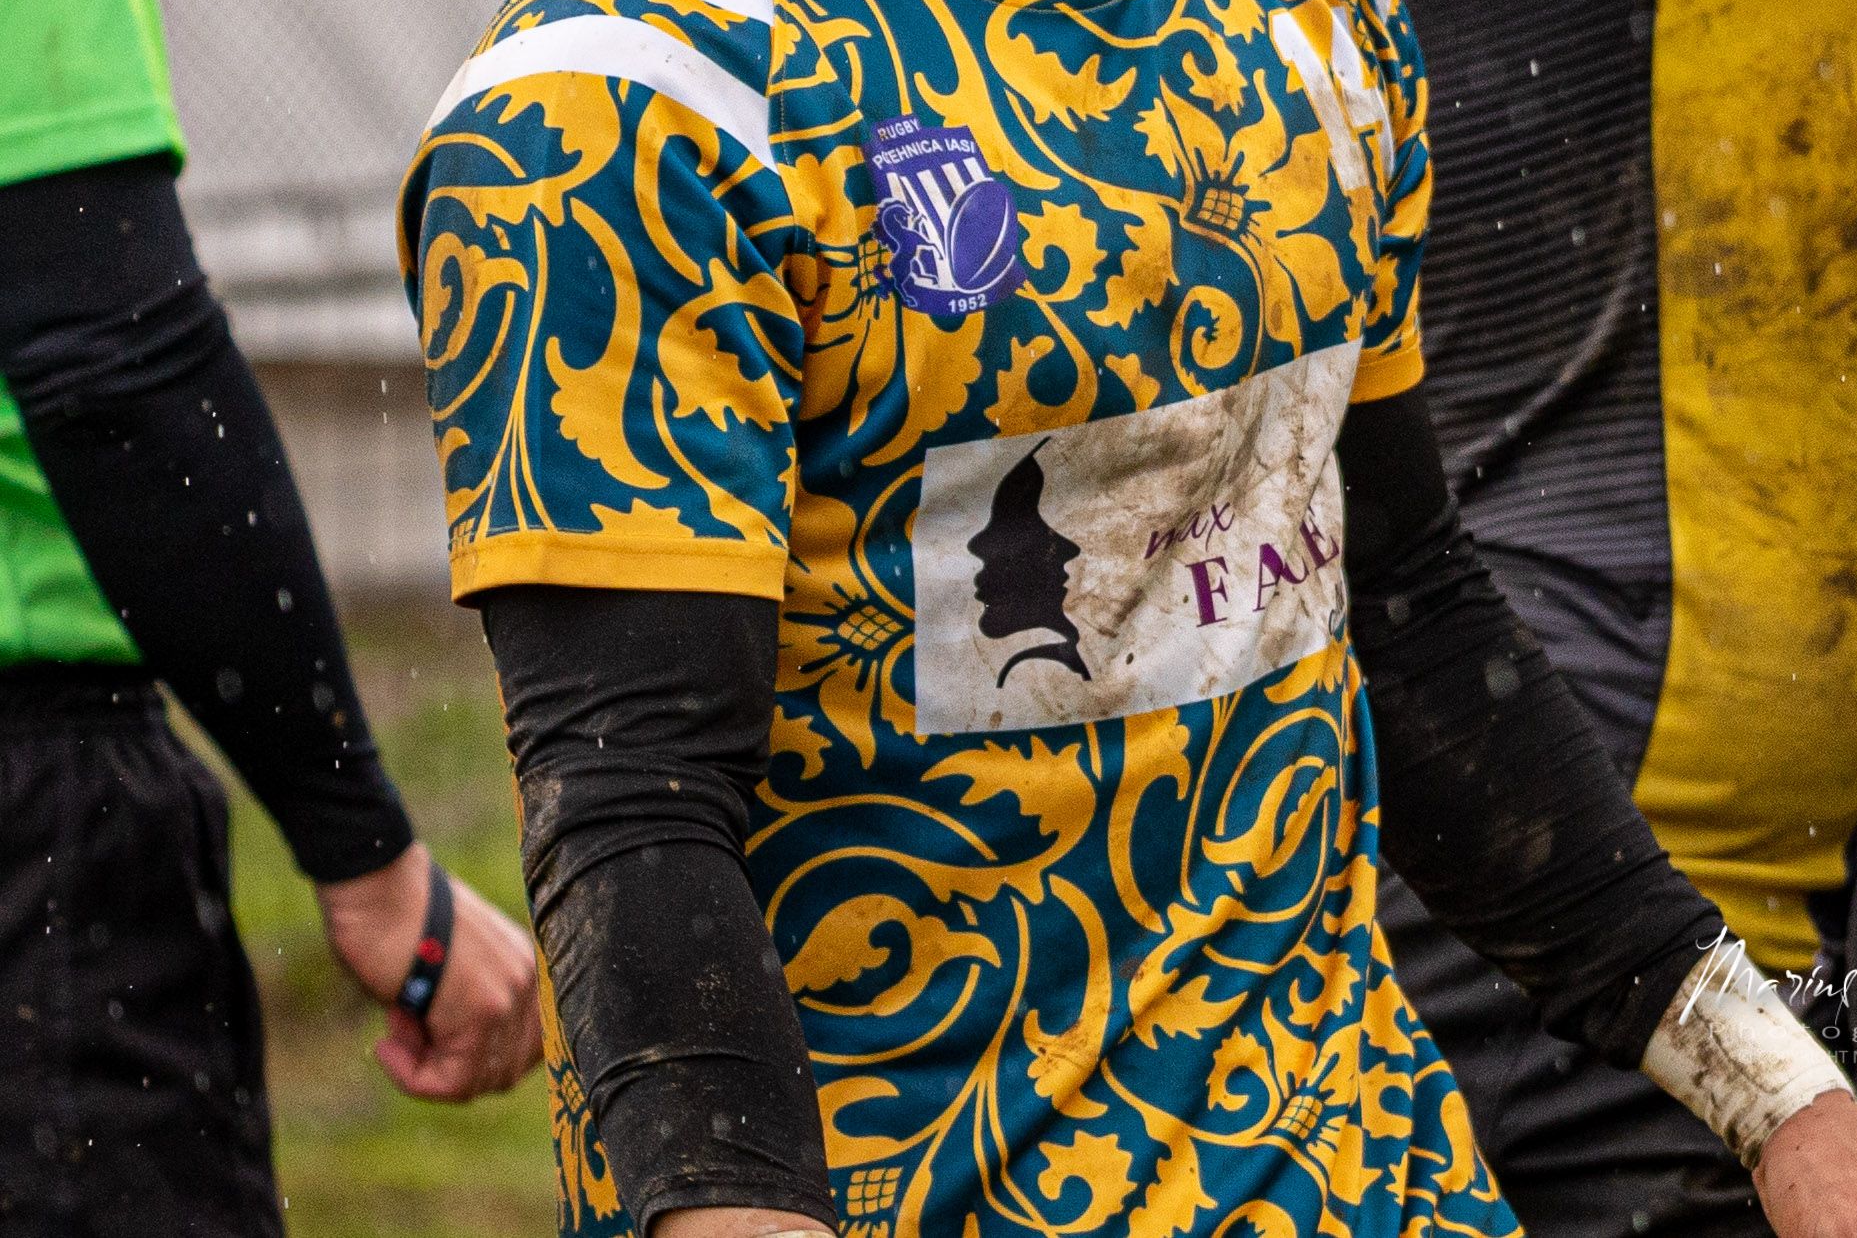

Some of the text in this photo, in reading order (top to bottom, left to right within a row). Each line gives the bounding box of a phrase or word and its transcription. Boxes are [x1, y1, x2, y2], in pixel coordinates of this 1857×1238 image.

[877, 118, 920, 142] RUGBY
[944, 138, 975, 154] IASI
[948, 293, 988, 313] 1952
